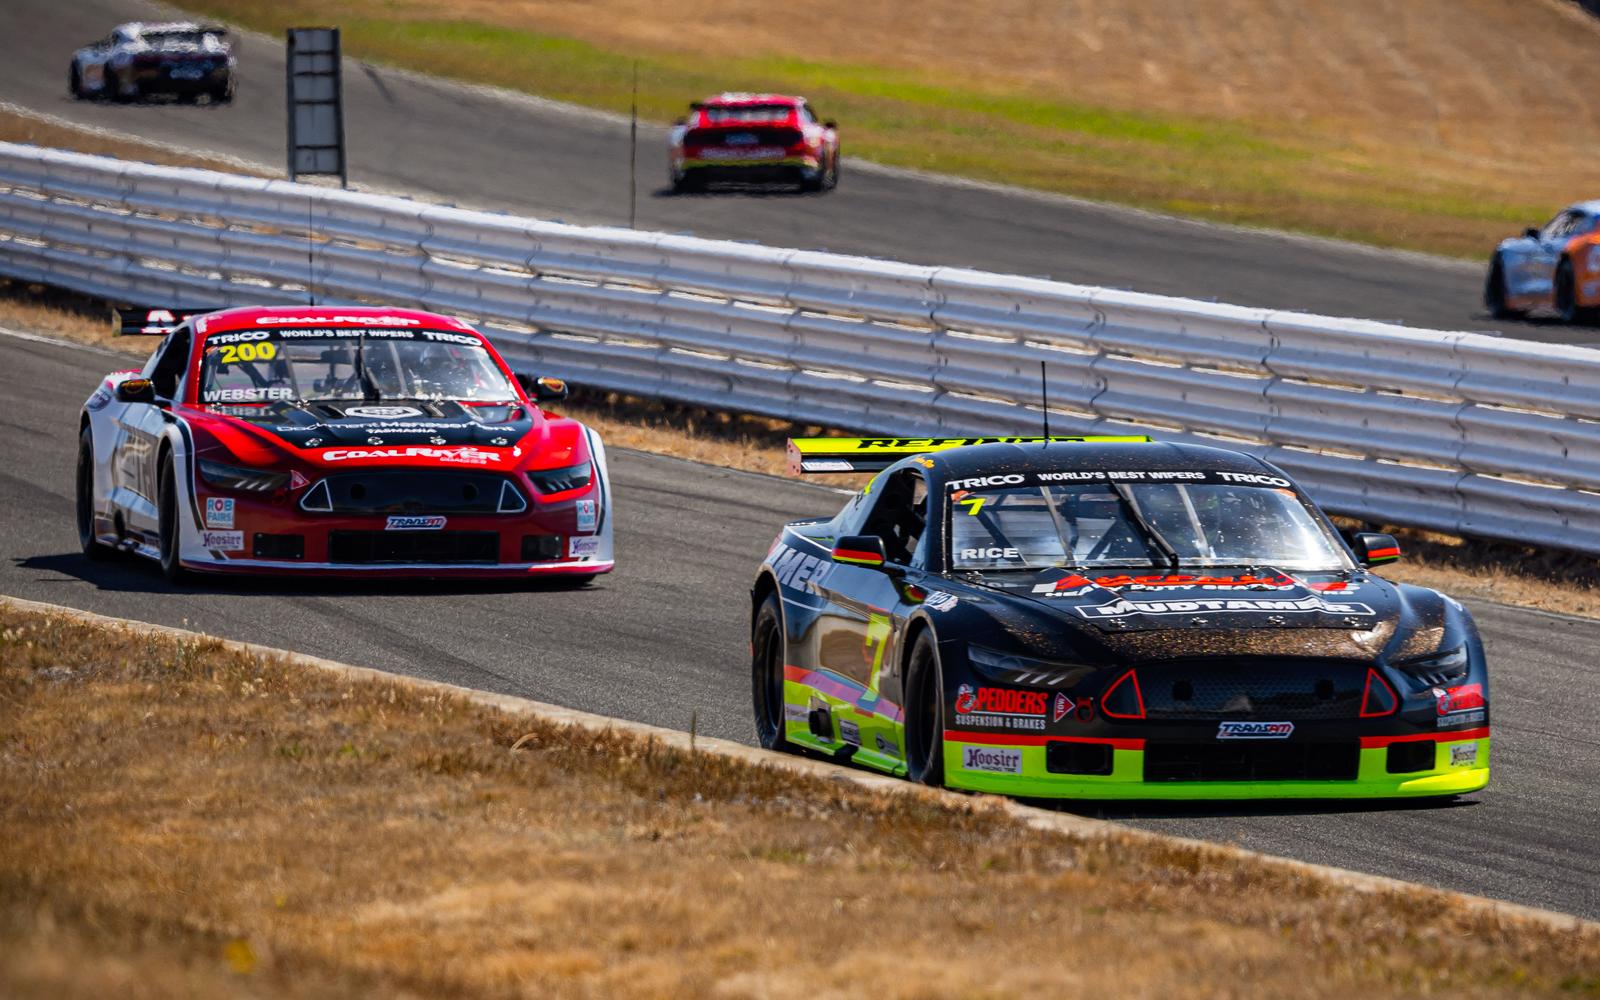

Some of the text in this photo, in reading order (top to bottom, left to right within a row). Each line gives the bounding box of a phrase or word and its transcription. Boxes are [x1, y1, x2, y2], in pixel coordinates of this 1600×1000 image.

[207, 331, 270, 345] TRICO
[368, 330, 414, 338] WIPERS
[422, 331, 483, 347] TRICO
[219, 341, 276, 364] 200
[203, 387, 294, 402] WEBSTER
[951, 474, 1024, 490] TRICO
[1037, 471, 1206, 481] WORLD'S BEST WIPERS
[1216, 471, 1291, 488] TRICO
[960, 498, 986, 516] 7
[960, 547, 1019, 560] RICE
[1096, 600, 1356, 615] MUDTAMER
[857, 613, 892, 702] 7
[976, 687, 1048, 714] PEDDERS
[955, 714, 1047, 730] SUSPENSION & BRAKES
[966, 748, 1019, 768] Hoosier
